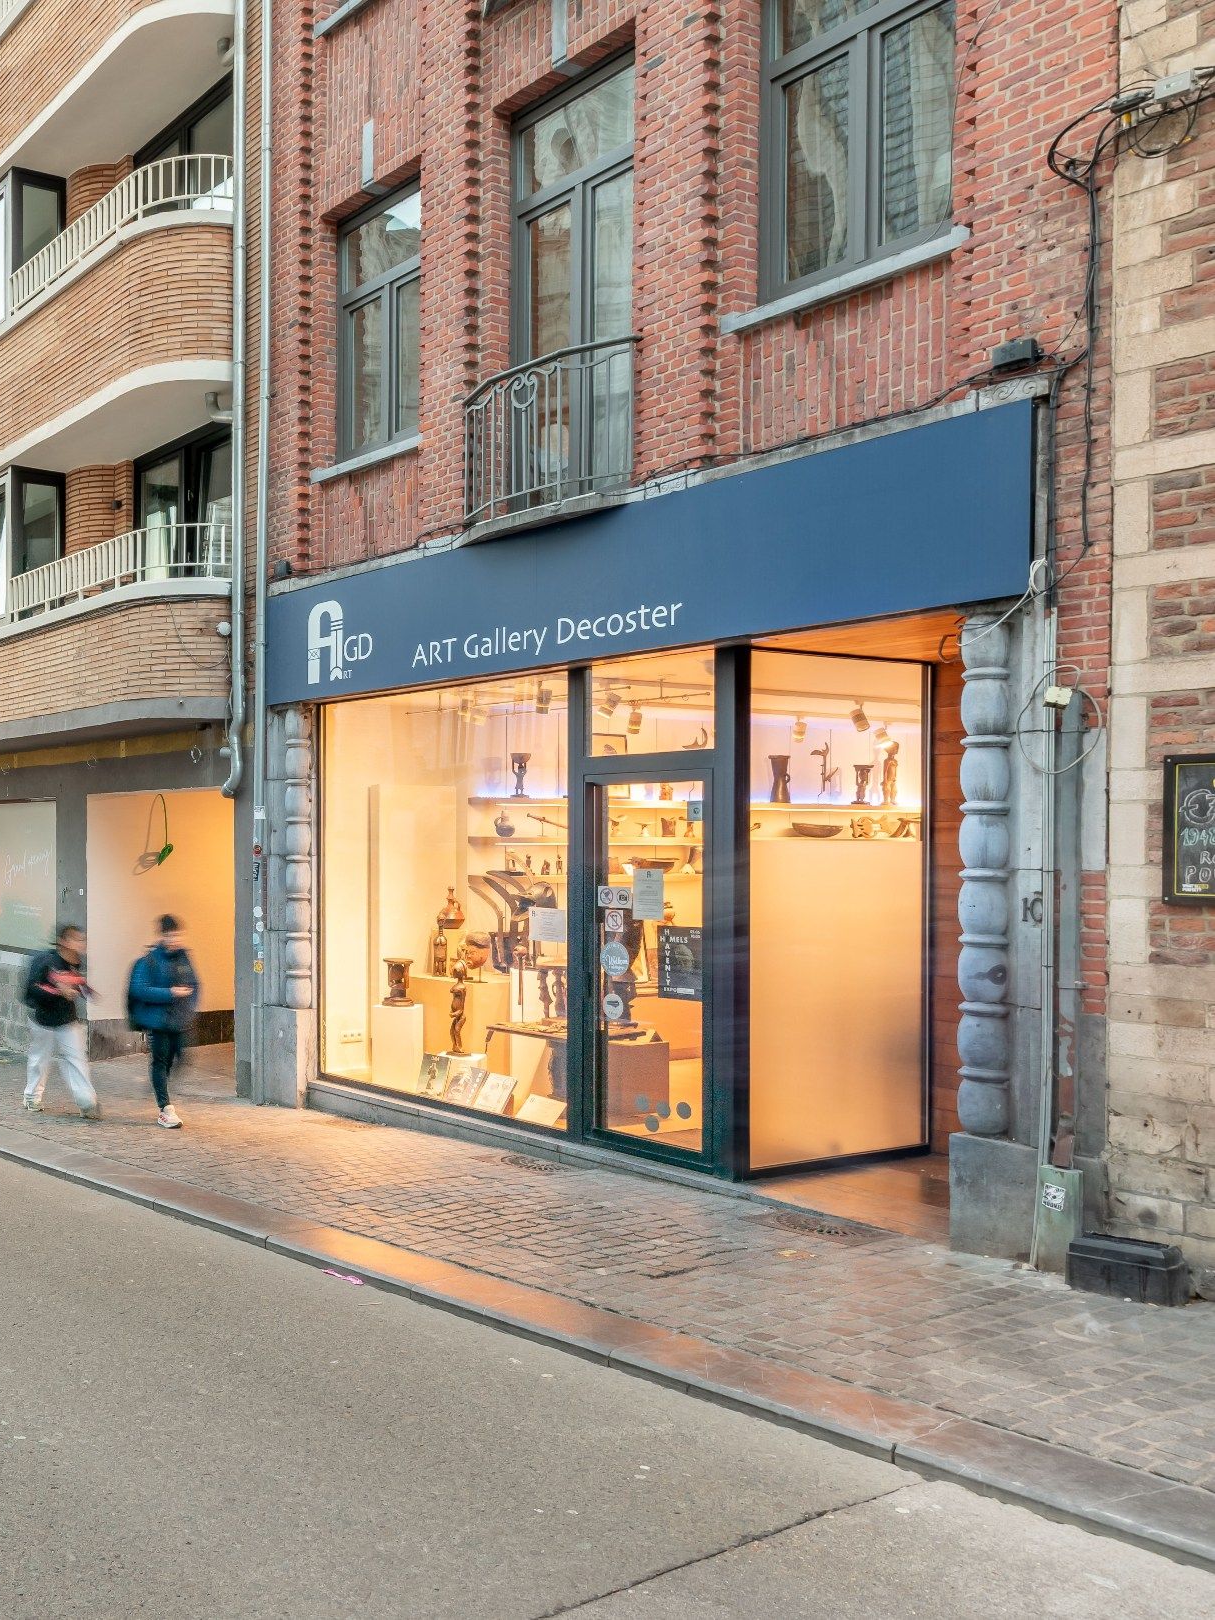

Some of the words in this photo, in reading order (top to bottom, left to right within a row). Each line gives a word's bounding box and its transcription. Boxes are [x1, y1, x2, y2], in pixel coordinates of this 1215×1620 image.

[411, 637, 458, 669] ART
[462, 625, 548, 659] Gallery
[556, 601, 684, 646] Decoster
[659, 935, 689, 944] HMELS
